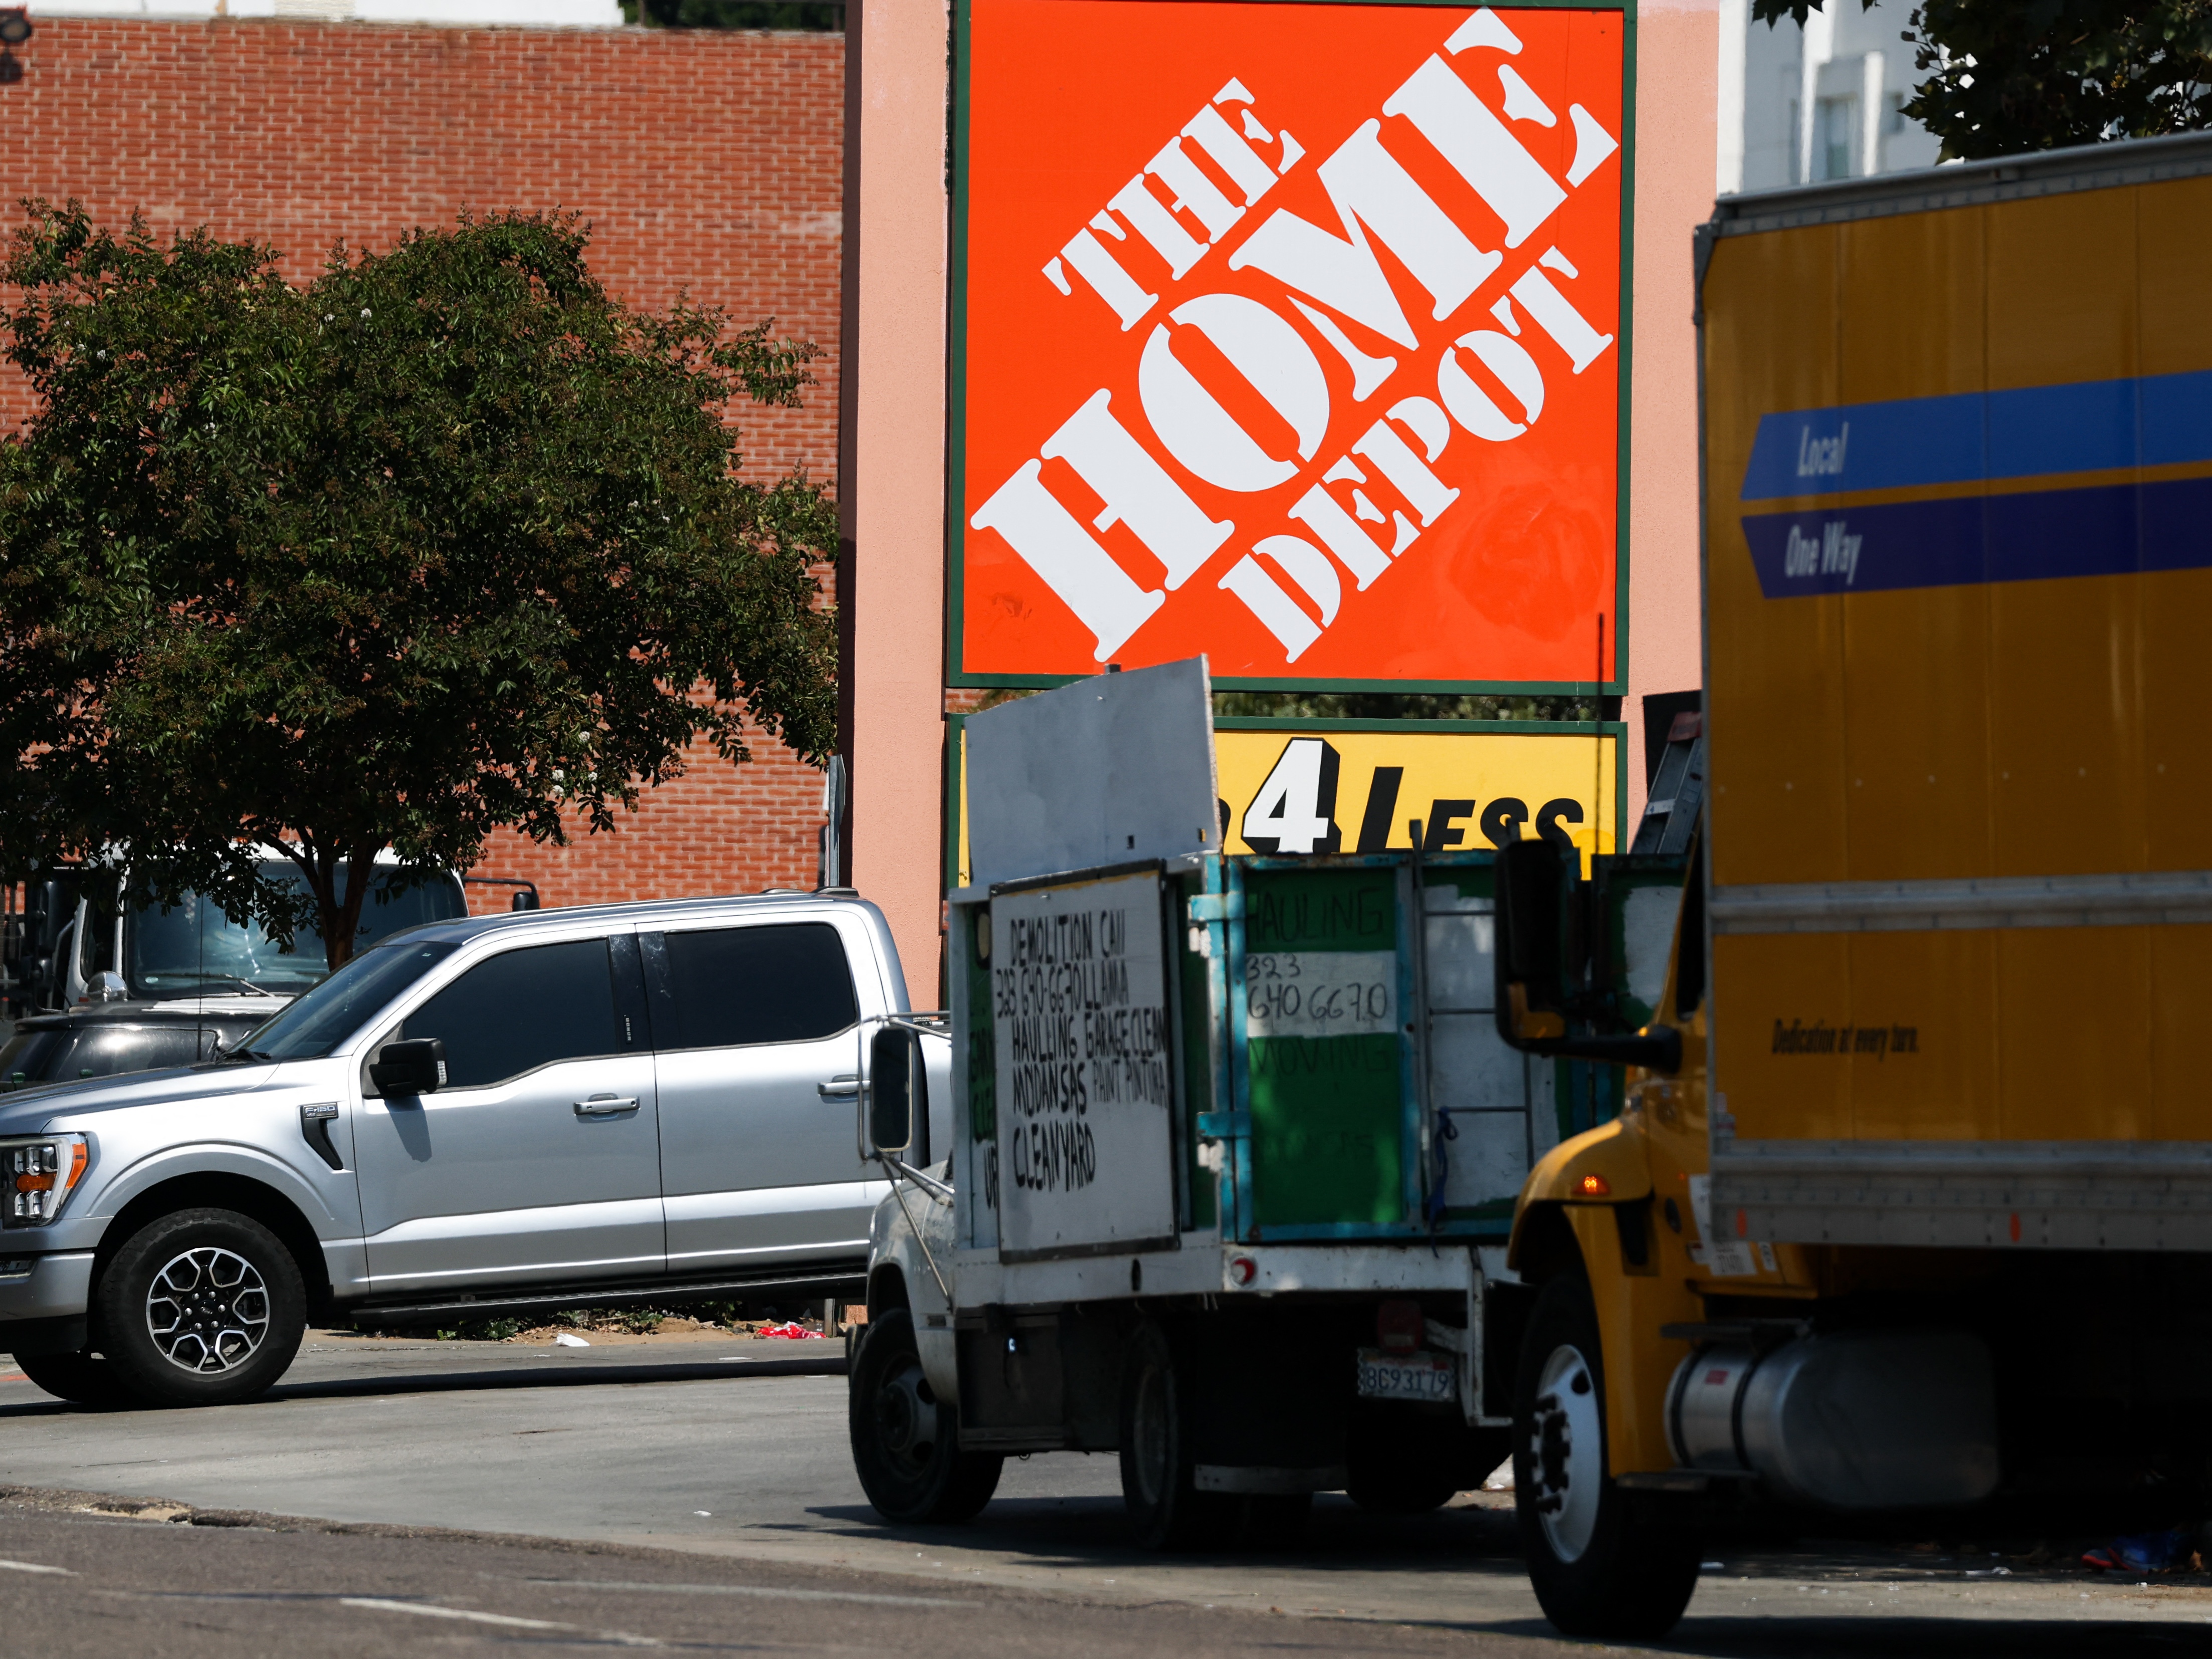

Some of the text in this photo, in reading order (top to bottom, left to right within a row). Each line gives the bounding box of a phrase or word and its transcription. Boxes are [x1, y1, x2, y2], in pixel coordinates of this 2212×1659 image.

[1042, 77, 1306, 332] THE
[970, 6, 1619, 662] HOME
[1218, 245, 1613, 663] DEPOT
[1797, 421, 1849, 477] Local
[1784, 522, 1863, 585] One Way
[1011, 911, 1093, 967] DEMOLITION
[1245, 887, 1384, 944] HAULING
[1246, 953, 1302, 981] 323
[1248, 983, 1301, 1020] 640
